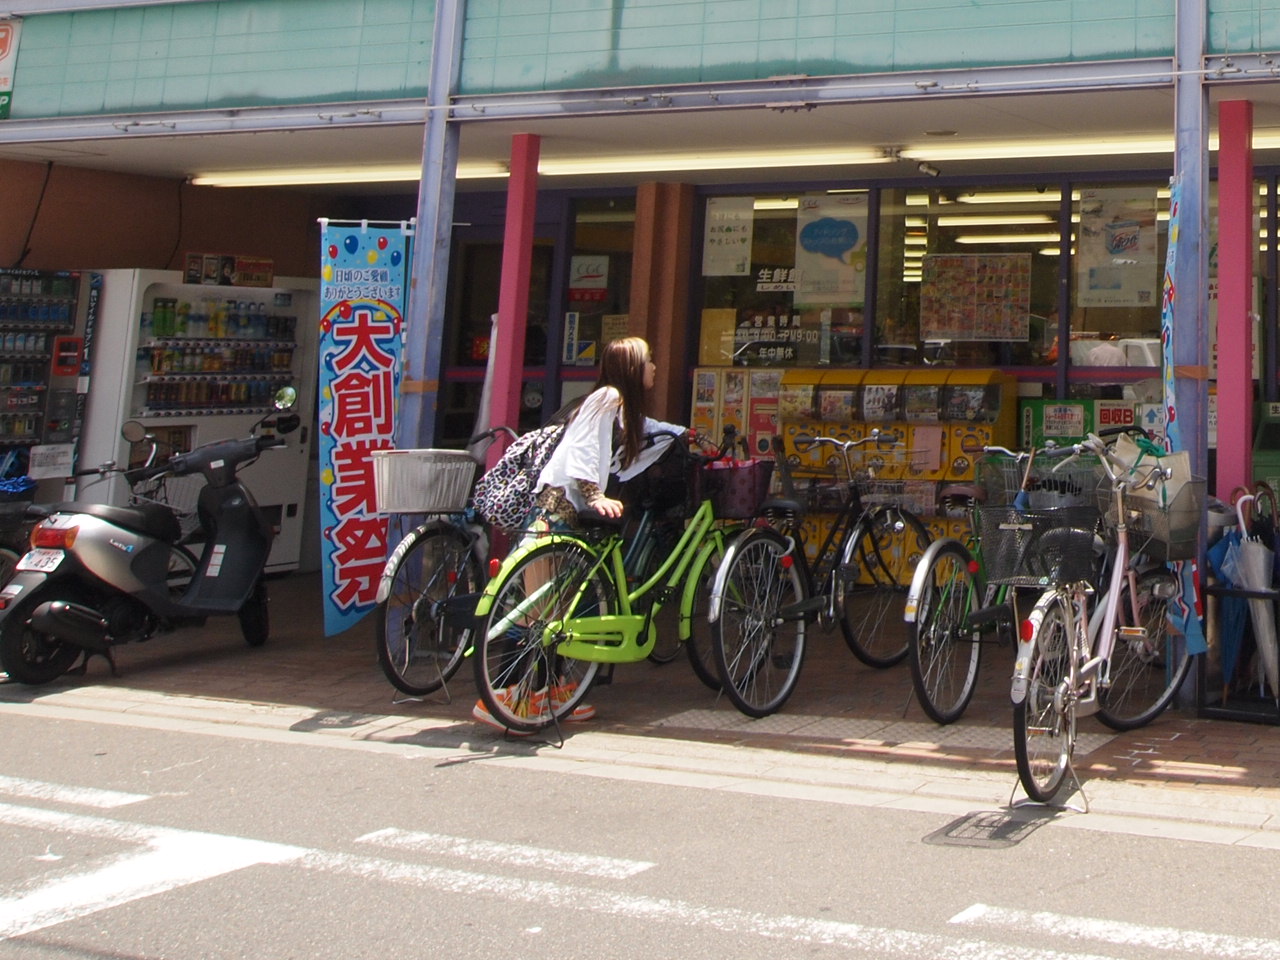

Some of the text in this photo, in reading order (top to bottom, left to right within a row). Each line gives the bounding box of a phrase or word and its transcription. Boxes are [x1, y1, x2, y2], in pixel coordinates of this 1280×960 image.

[759, 347, 794, 359] 年中無休
[1099, 408, 1134, 425] 回収B
[331, 310, 396, 608] 大創業祭
